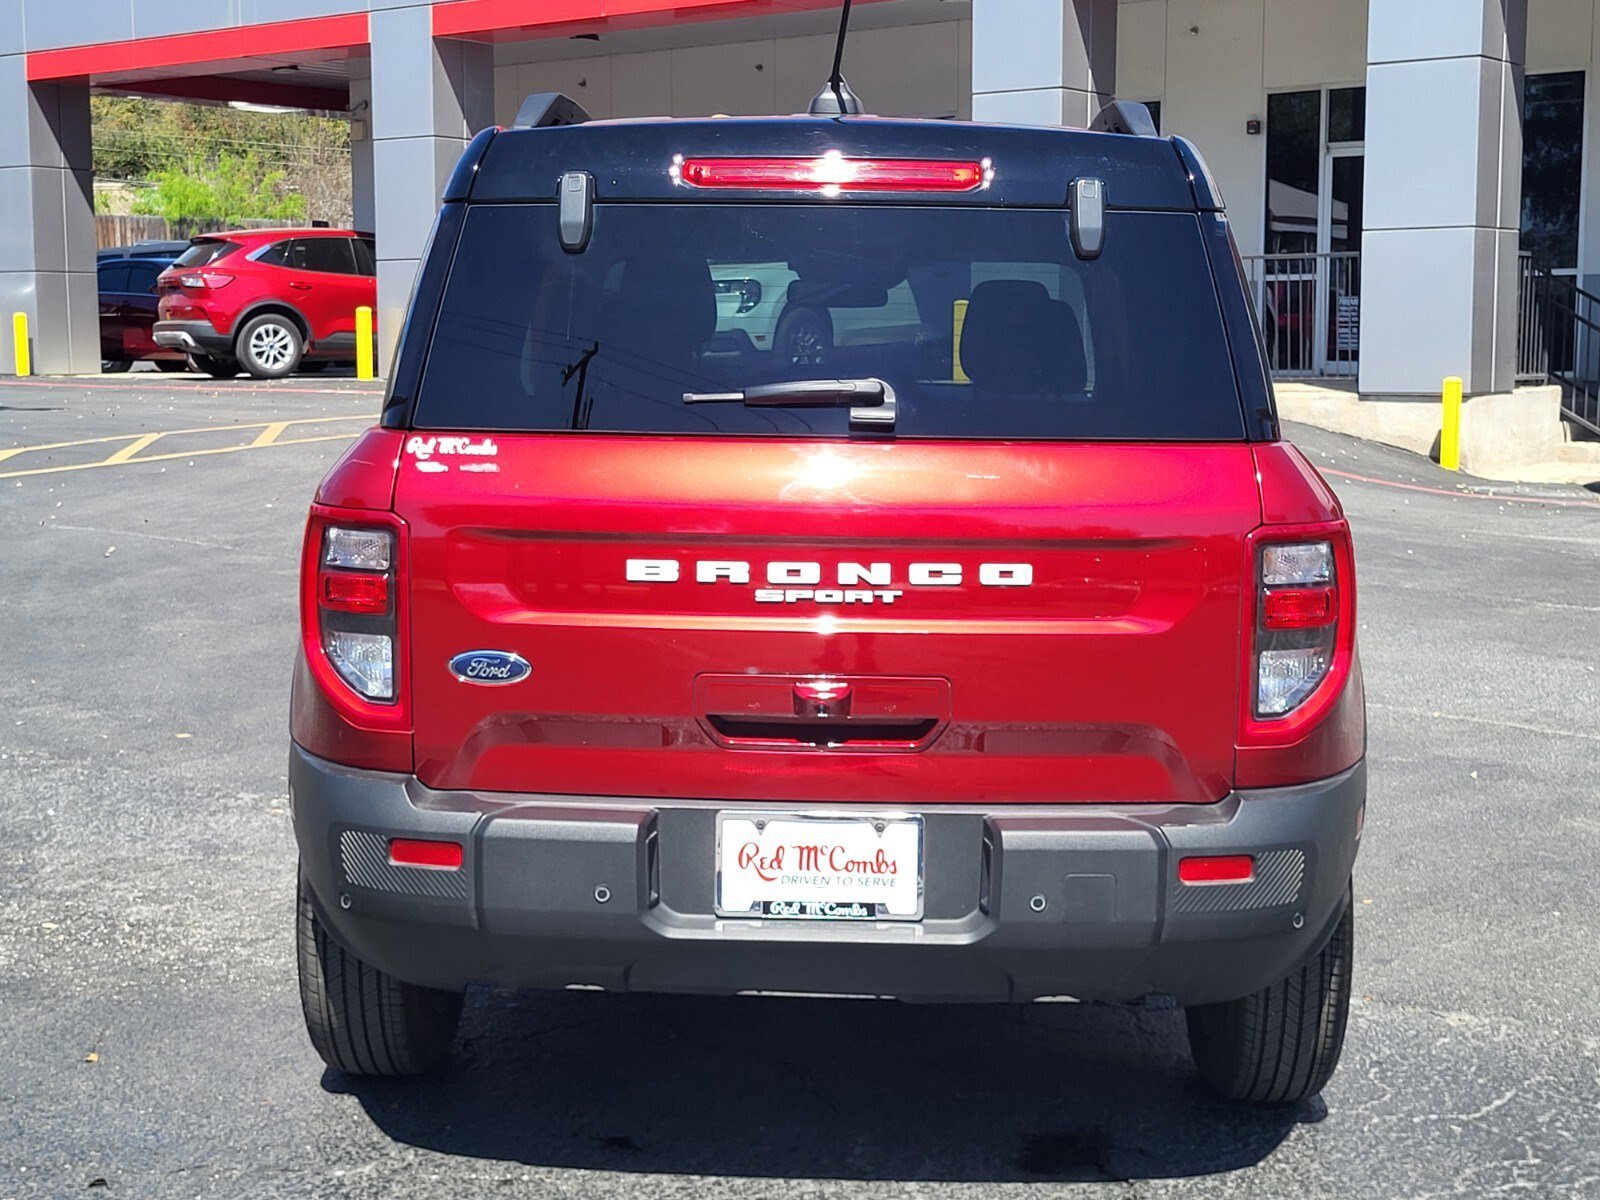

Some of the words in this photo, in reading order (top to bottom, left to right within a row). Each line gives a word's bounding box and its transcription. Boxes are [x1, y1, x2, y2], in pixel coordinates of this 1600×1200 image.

[626, 558, 1033, 587] BRONCO
[754, 588, 904, 604] SPORT
[466, 657, 512, 678] Ford
[738, 842, 785, 882] Red
[791, 844, 898, 875] McCombs
[780, 874, 831, 886] DRIVEN
[836, 876, 853, 887] TO
[857, 877, 897, 888] SERVE
[769, 901, 800, 916] Red
[801, 901, 868, 917] McCombs
